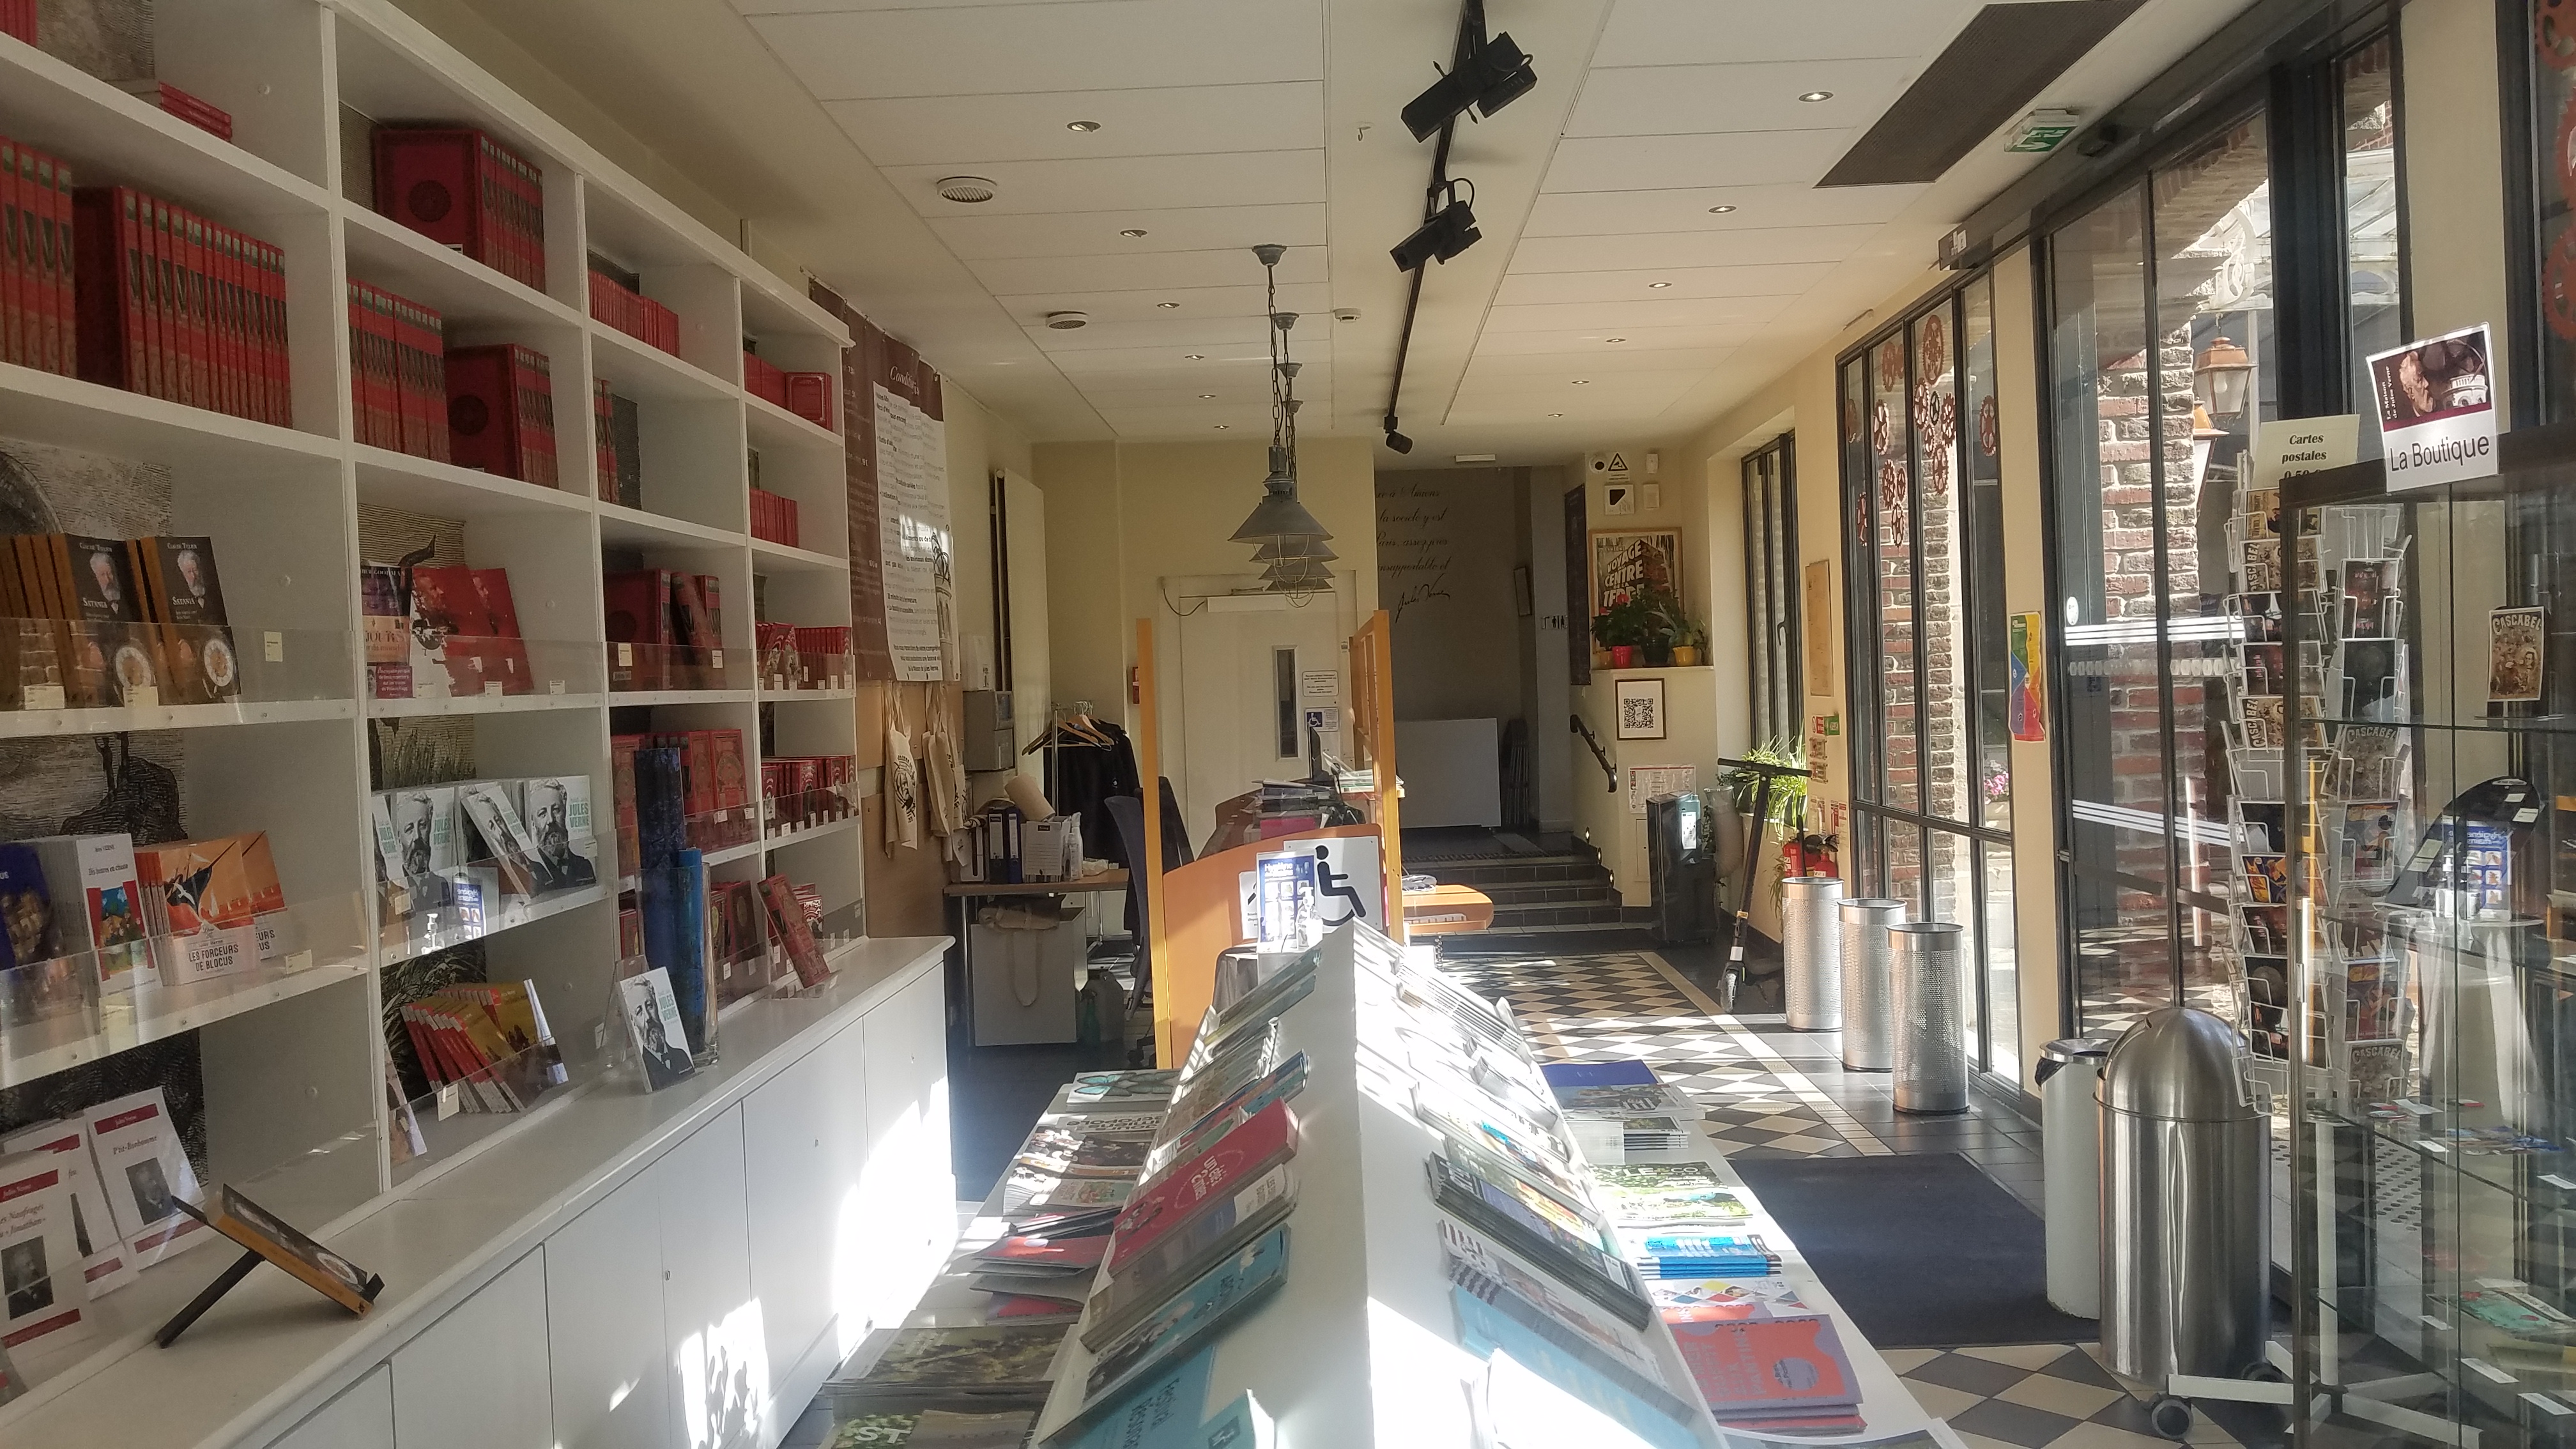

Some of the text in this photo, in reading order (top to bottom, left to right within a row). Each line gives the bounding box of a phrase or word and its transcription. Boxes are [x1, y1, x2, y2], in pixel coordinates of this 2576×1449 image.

[2382, 381, 2390, 409] Maison
[2289, 434, 2324, 445] Cartes
[2281, 450, 2327, 464] postales
[2390, 435, 2489, 471] La Boutique
[1607, 540, 1641, 573] VOYAGE
[1604, 559, 1644, 587] CENTRE
[2492, 614, 2542, 635] CASCABEL
[569, 802, 589, 816] JULES
[569, 815, 590, 829] VERNE
[188, 944, 239, 962] LES FORCEURS
[195, 956, 234, 972] DE BLOCUS
[2352, 1045, 2402, 1064] CASCABEL
[1600, 1167, 1657, 1177] YLE
